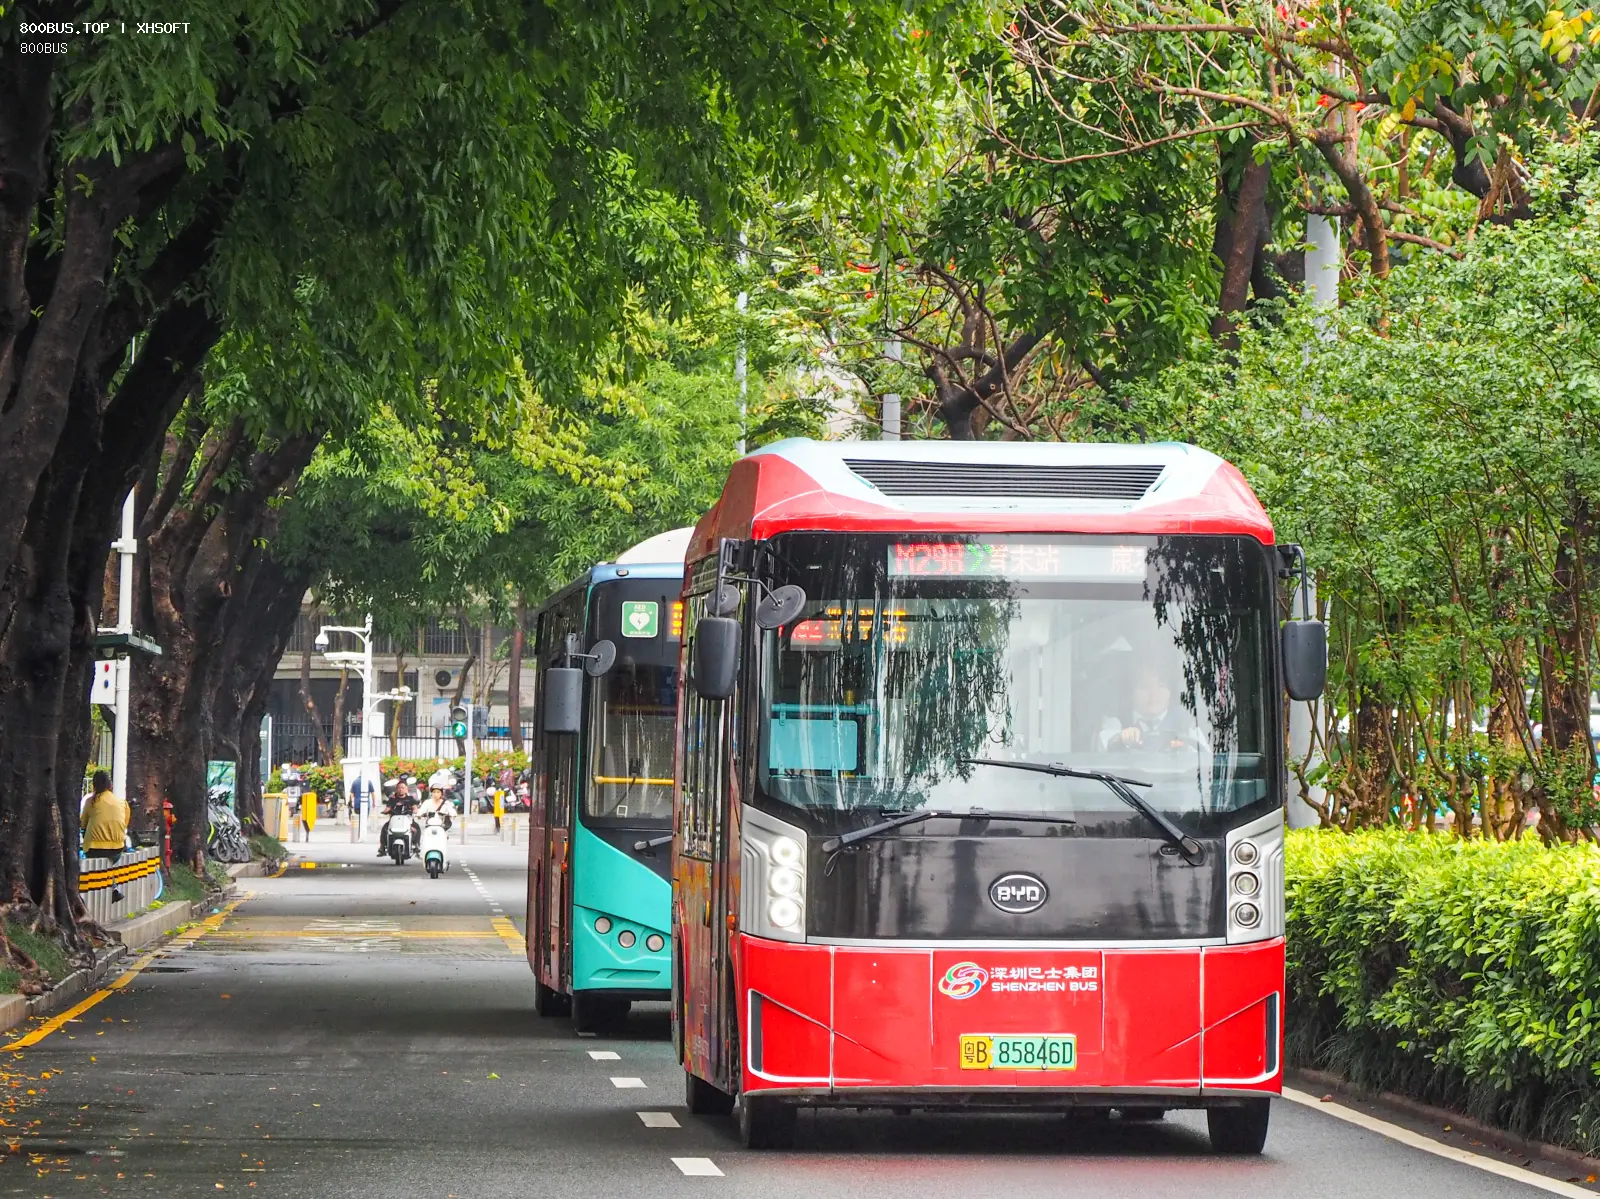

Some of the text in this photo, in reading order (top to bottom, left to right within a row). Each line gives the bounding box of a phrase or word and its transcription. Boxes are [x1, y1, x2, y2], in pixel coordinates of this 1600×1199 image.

[895, 544, 965, 575] M298
[997, 886, 1040, 901] BYD
[990, 966, 1098, 979] 深圳巴士集团
[991, 981, 1098, 992] SHENZHEN BUS
[964, 1040, 1073, 1064] 粤B 85846D
